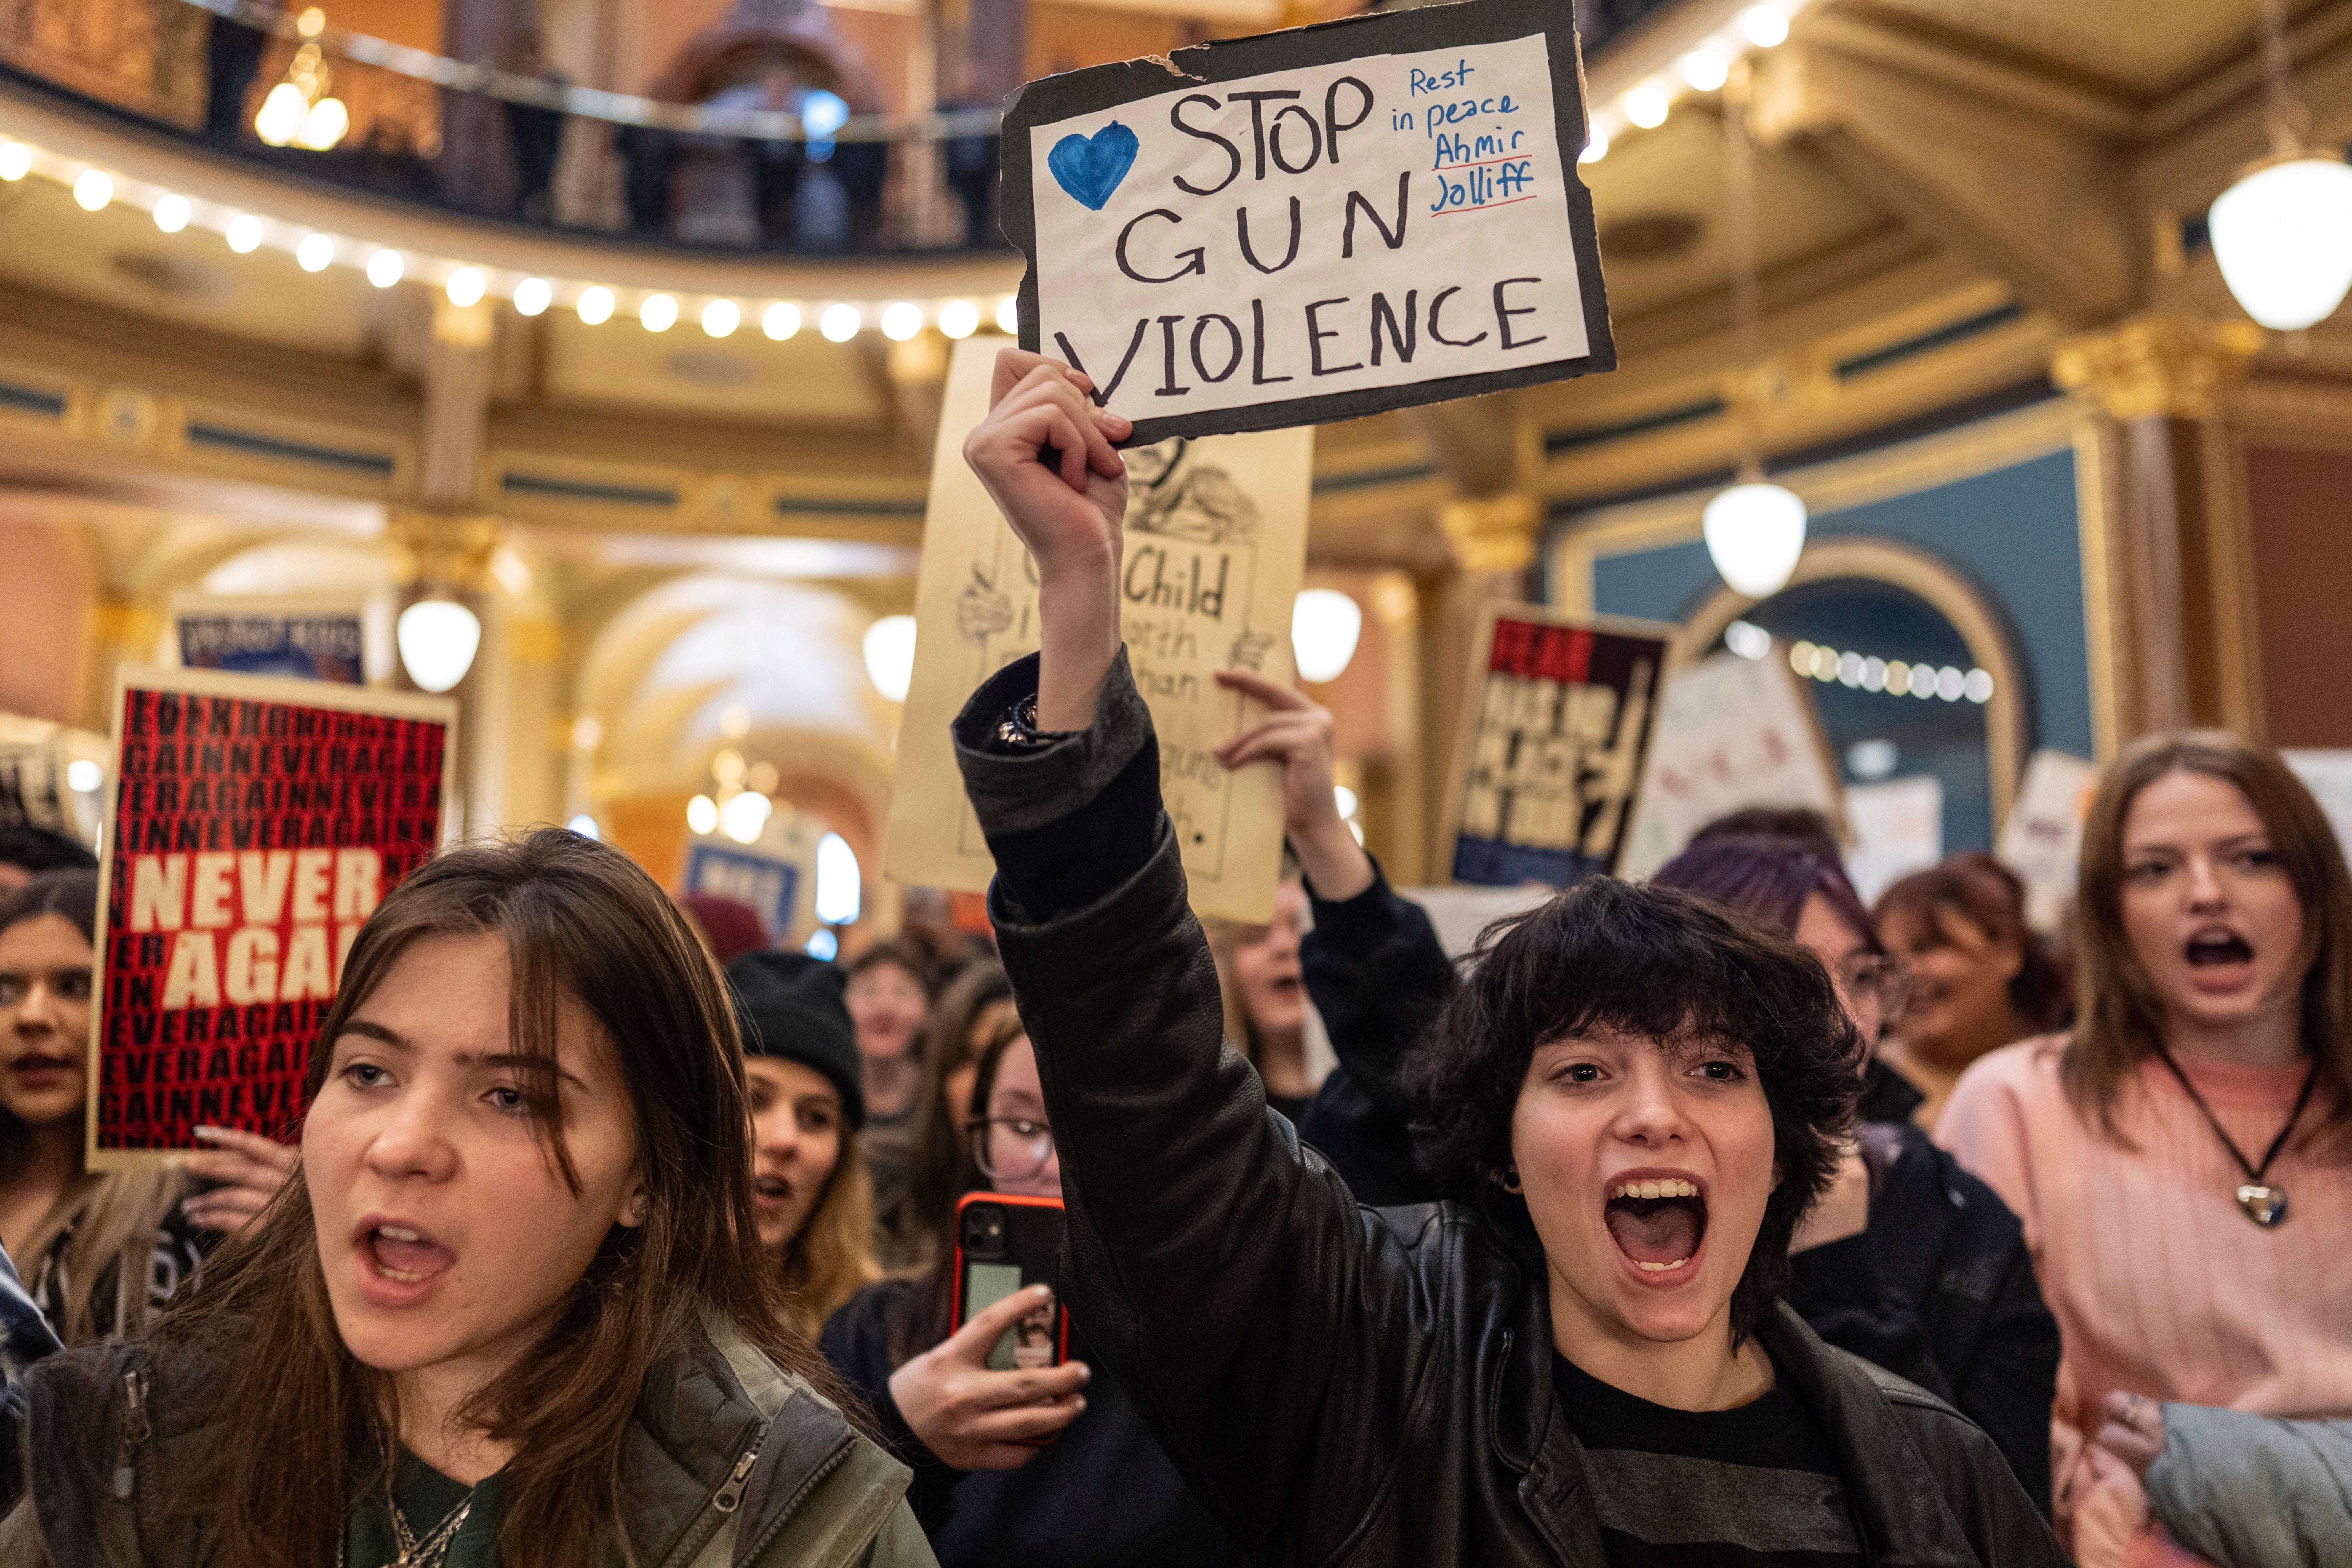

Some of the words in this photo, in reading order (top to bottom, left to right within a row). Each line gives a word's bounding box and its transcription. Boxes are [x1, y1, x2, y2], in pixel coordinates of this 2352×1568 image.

[1410, 59, 1475, 97] Rest
[1170, 76, 1373, 197] STOP
[1391, 107, 1414, 131] in
[1427, 93, 1519, 141] peace
[1434, 129, 1525, 169] Ahmir
[1430, 161, 1534, 212] Jolliff
[1115, 171, 1412, 284] GUN
[1054, 278, 1548, 408] VIOLENCE
[1122, 544, 1232, 623] Child
[1133, 659, 1200, 704] han
[129, 848, 384, 934] NEVER
